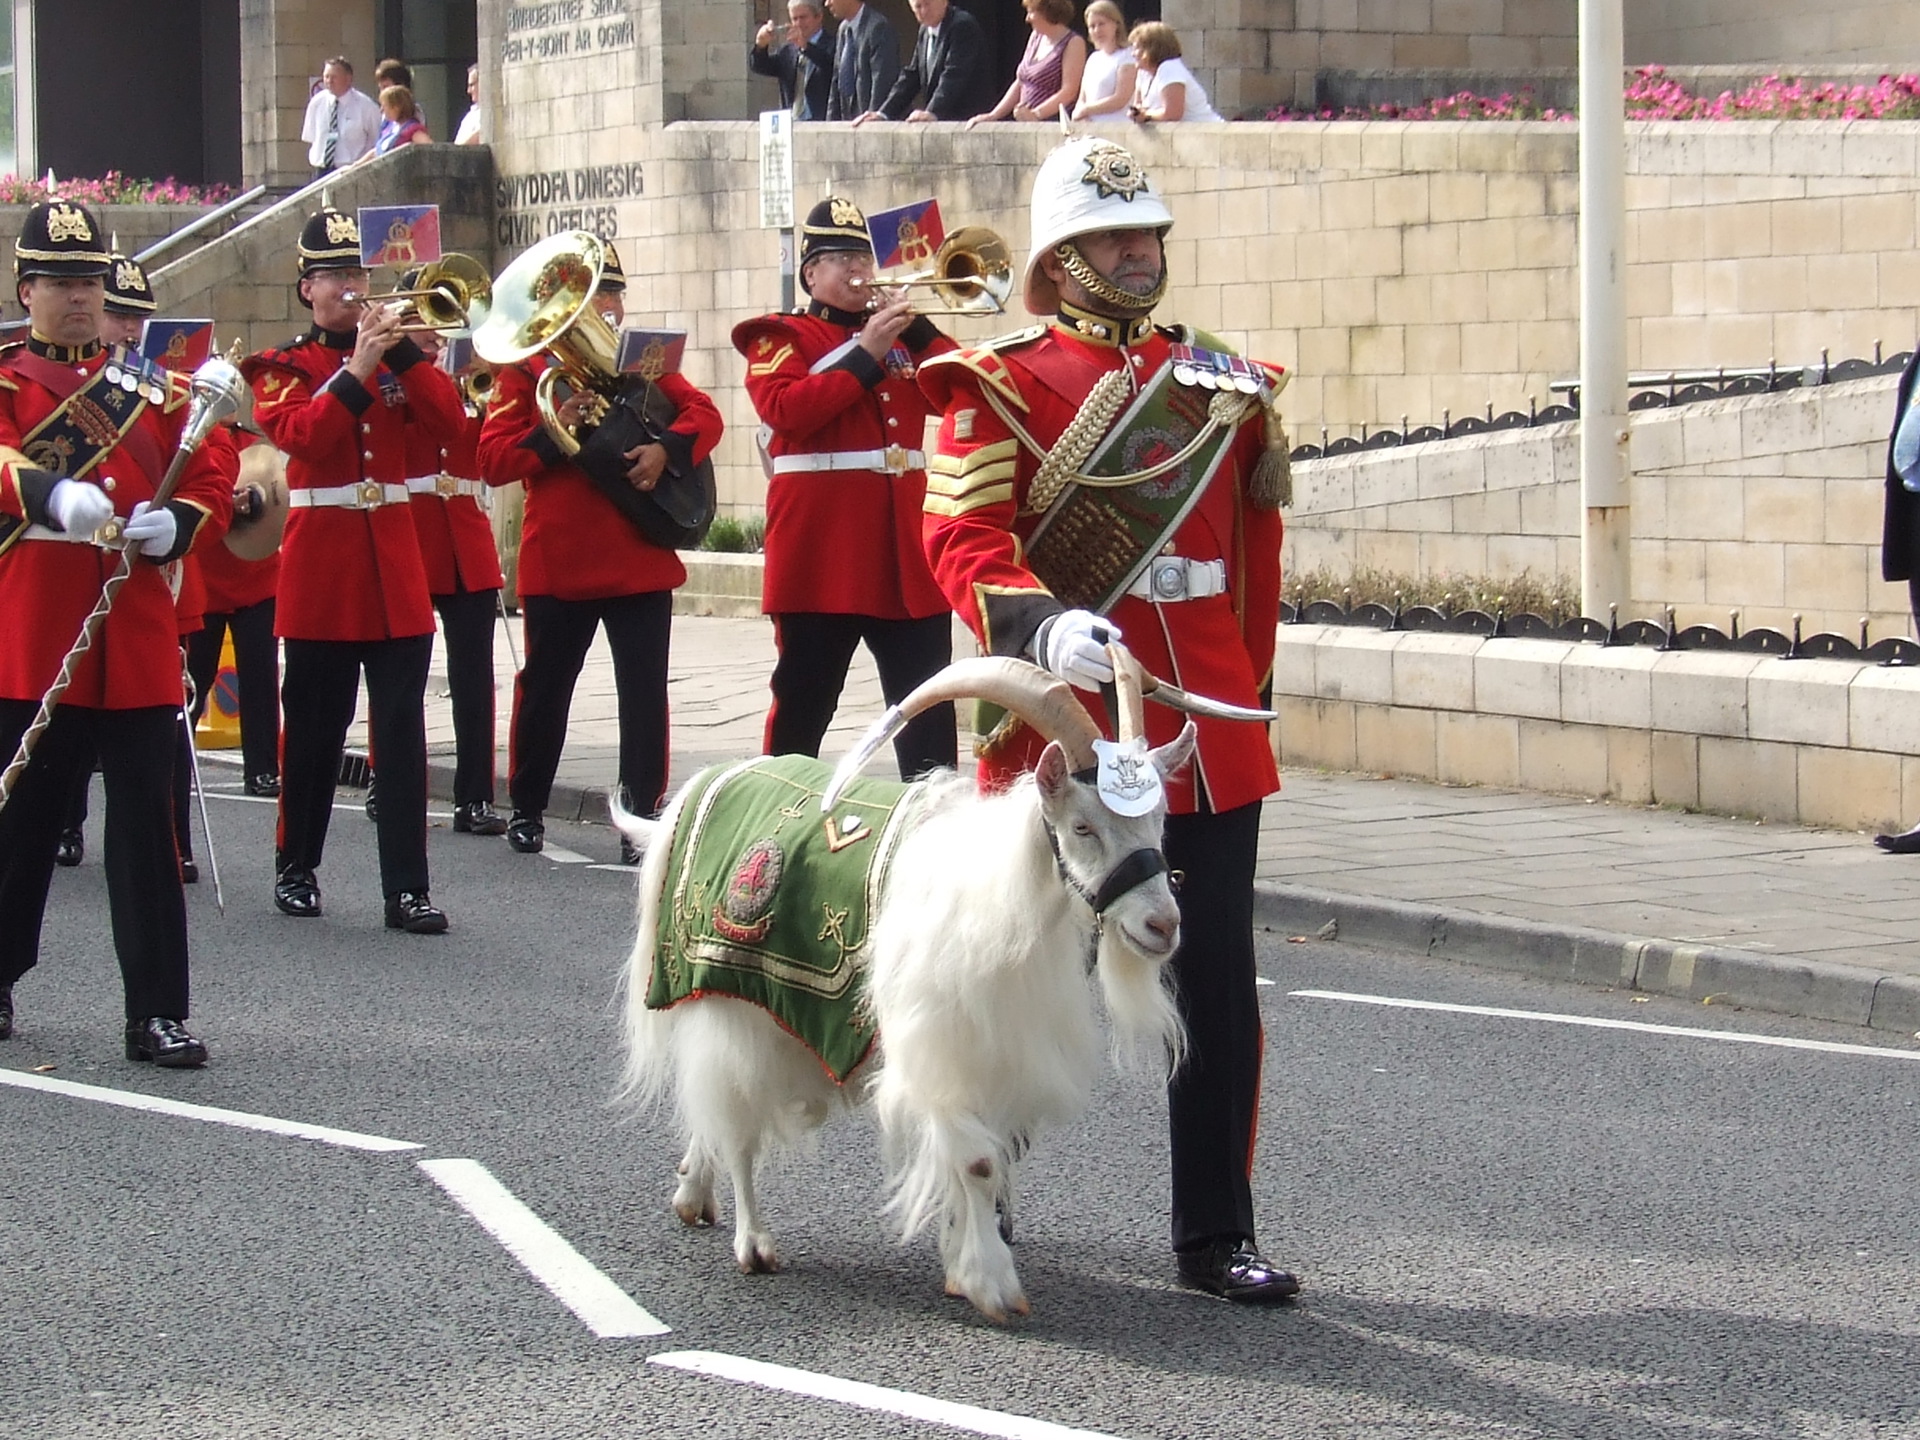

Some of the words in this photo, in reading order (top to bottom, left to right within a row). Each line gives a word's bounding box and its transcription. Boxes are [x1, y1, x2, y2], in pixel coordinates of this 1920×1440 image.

[501, 31, 570, 63] PEN-Y-BONT
[575, 28, 591, 51] AR
[597, 21, 635, 48] OGWR
[496, 170, 571, 208] SWYDDFA
[575, 162, 644, 200] DINESIG
[498, 212, 540, 246] CIVIC
[547, 205, 618, 238] OFFICES
